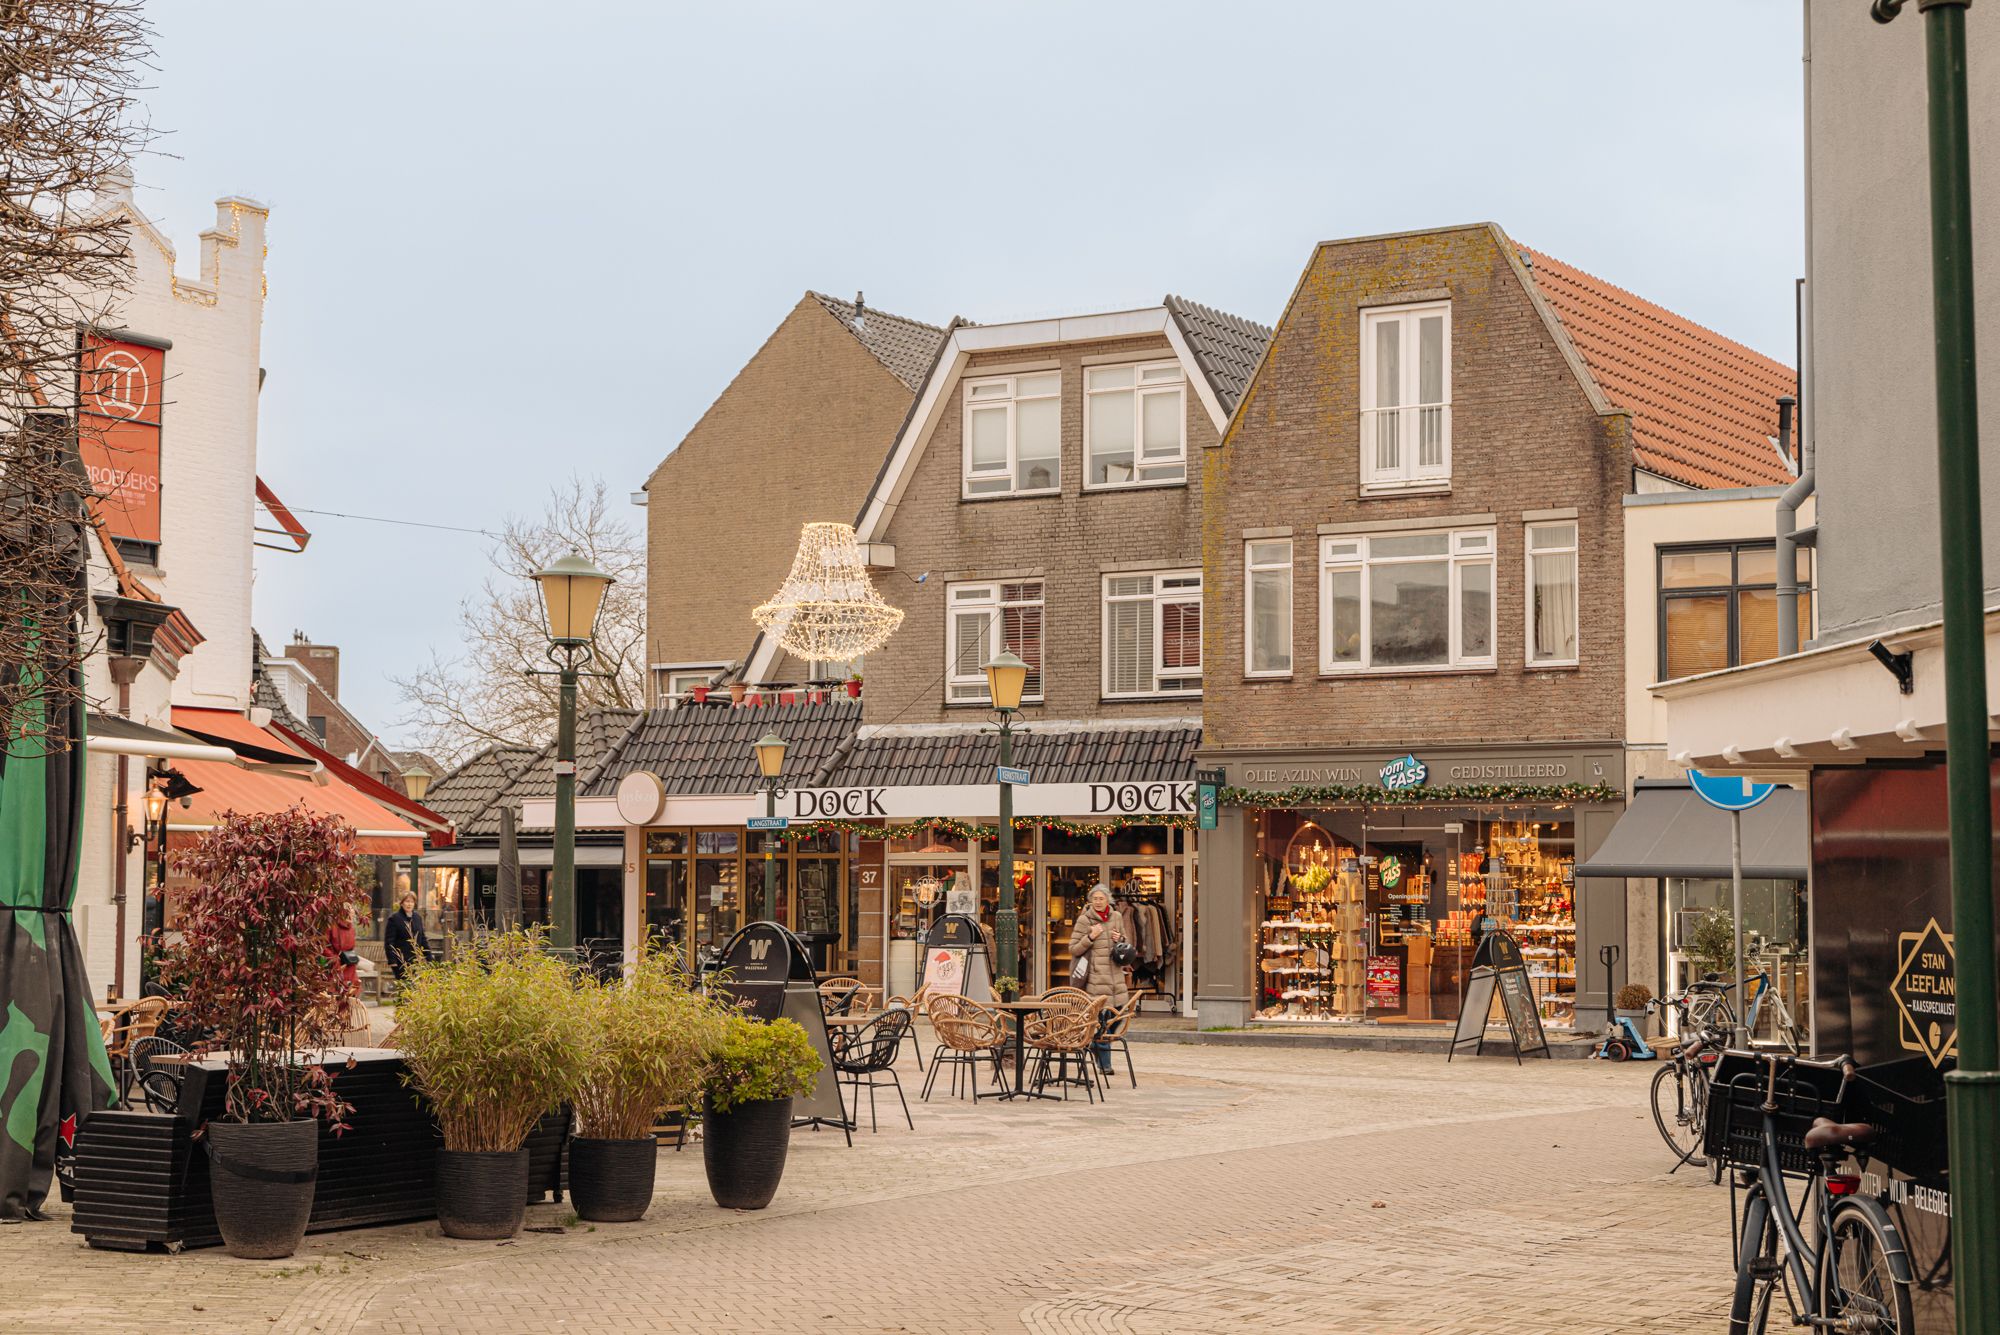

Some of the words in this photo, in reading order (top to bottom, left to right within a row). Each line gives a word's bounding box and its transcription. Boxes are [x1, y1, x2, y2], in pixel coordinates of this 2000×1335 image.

[1245, 769, 1278, 783] OLIE
[1281, 769, 1322, 782] AZIJN
[1325, 767, 1362, 781] WIJN
[1379, 760, 1404, 779] vom
[1388, 764, 1426, 791] FASS
[1450, 763, 1567, 780] GEDISTILLEERD
[794, 788, 888, 818] DOCK
[1089, 783, 1194, 813] DOCK
[751, 819, 782, 828] LANGSTRAAT
[861, 871, 877, 884] 37
[1921, 953, 1946, 970] STAN
[1905, 974, 1957, 996] LEEFLAN
[1912, 999, 1956, 1017] KAASSPECIALIST
[1889, 1178, 1908, 1206] WIJN
[1914, 1184, 1948, 1217] BELEGDE
